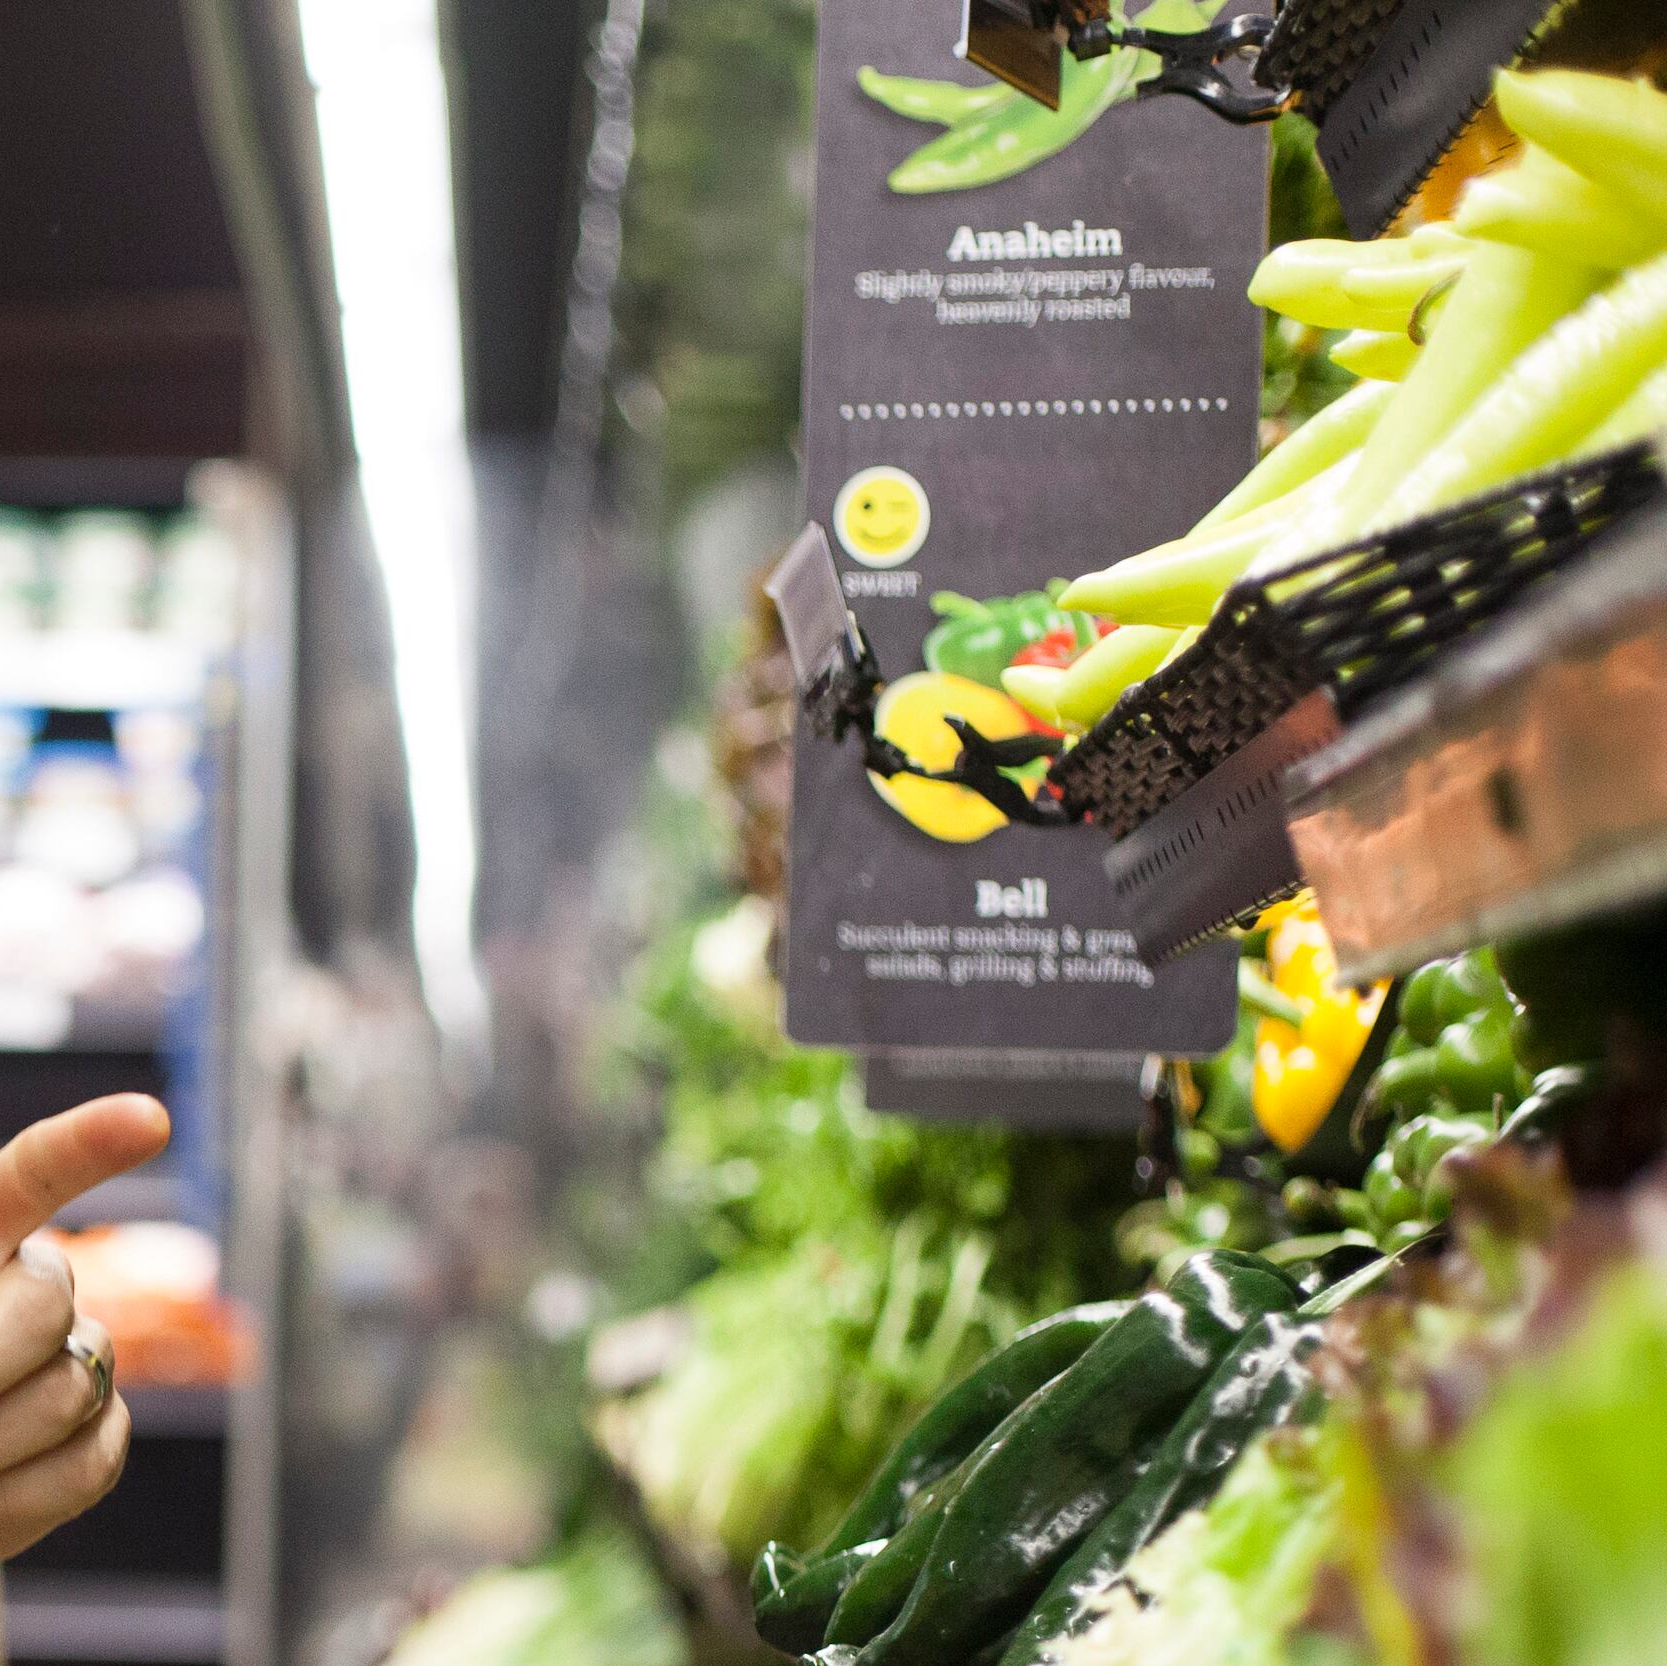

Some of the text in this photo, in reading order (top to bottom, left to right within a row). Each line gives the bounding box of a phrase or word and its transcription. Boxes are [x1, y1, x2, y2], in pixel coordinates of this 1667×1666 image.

[947, 219, 1124, 261] Anaheim
[855, 267, 944, 304] Slightly
[937, 292, 1132, 328] heavenly roasted
[842, 570, 923, 598] SWEET
[976, 877, 1049, 918] Bell
[952, 921, 1060, 958] snacking
[1061, 923, 1083, 953] &
[948, 949, 1036, 988] grilling
[1037, 951, 1059, 982] &
